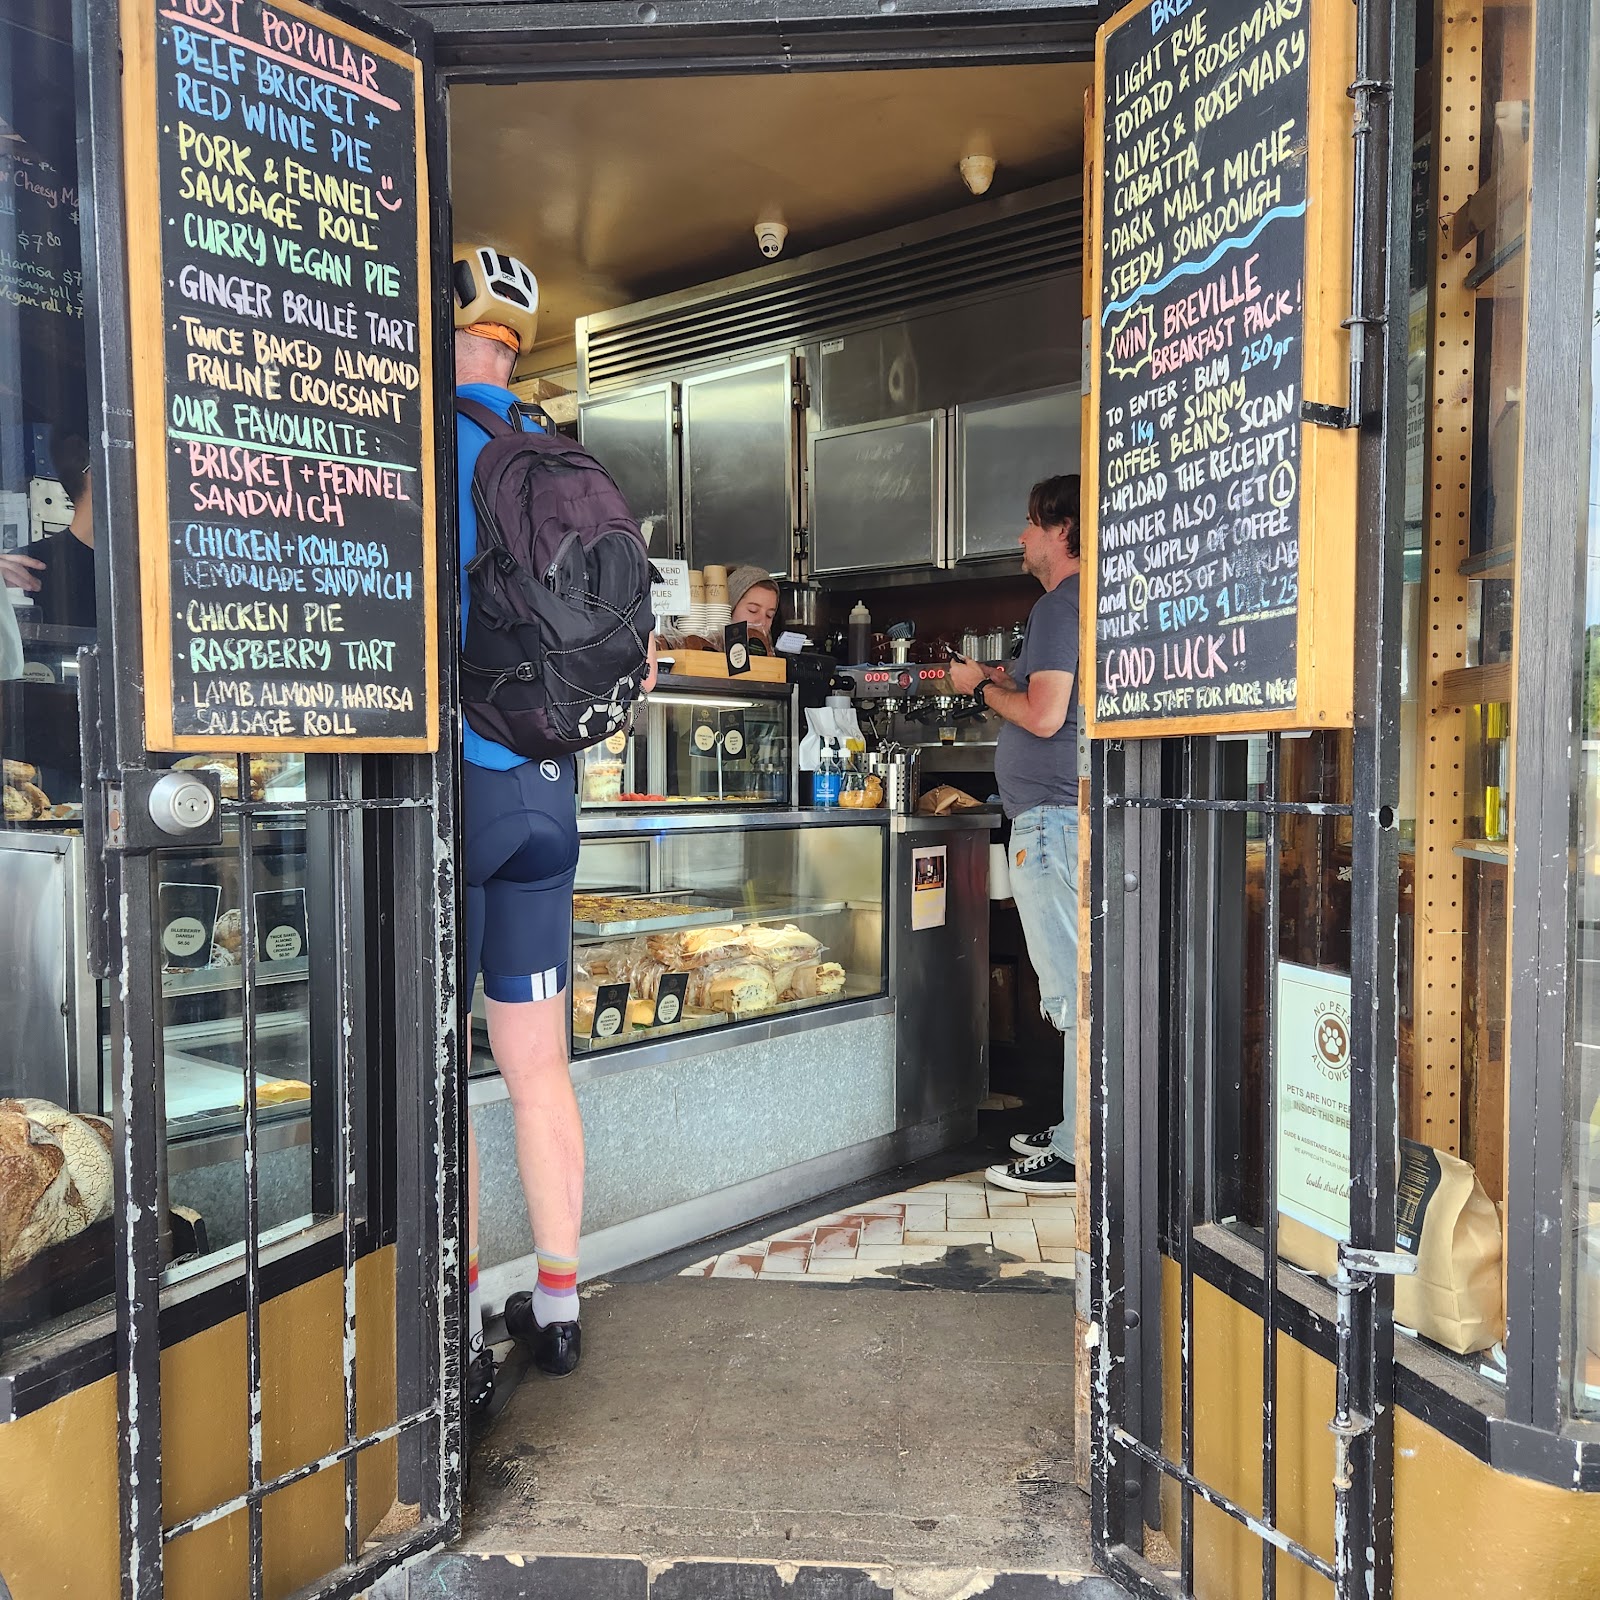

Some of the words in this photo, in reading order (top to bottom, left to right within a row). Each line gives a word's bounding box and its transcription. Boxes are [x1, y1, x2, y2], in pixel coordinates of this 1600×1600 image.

[262, 9, 379, 90] POPULAR
[1151, 0, 1192, 36] BRE
[171, 26, 245, 85] BEEF
[257, 57, 359, 126] BRISKET
[365, 111, 380, 130] +
[1115, 35, 1168, 106] LIGHT
[1171, 8, 1208, 67] RYE
[1115, 80, 1173, 144] POTATO
[1178, 65, 1191, 93] &
[1194, 0, 1302, 83] ROSEMARY
[175, 72, 231, 121] RED
[240, 94, 317, 153] WINE
[331, 128, 373, 174] PIE
[1114, 120, 1170, 184] OLIVES
[1172, 112, 1187, 142] &
[1195, 29, 1305, 132] ROSEMARY
[14, 170, 58, 208] Cheesy
[178, 121, 256, 183] PORK
[264, 158, 278, 183] &
[285, 157, 379, 220] FENNEL
[1112, 208, 1156, 259] DARK
[1164, 167, 1215, 227] MALT
[1223, 118, 1295, 195] MICHE
[1114, 141, 1200, 216] CIABATTA
[179, 166, 303, 231] SAUSAGE
[319, 207, 379, 250] ROLL
[1110, 242, 1164, 301] SEEDY
[1173, 175, 1281, 263] SOURDOUGH
[184, 213, 266, 266] CURRY
[273, 235, 351, 287] VEGAN
[364, 260, 400, 297] PIE
[41, 297, 61, 313] roll
[50, 286, 71, 302] roll
[179, 265, 272, 318] GINGER
[364, 311, 415, 352] TART
[1115, 315, 1147, 359] WIN
[1163, 253, 1262, 340] BREVILLE
[179, 315, 244, 355] TWICE
[252, 329, 322, 370] BAKED
[335, 347, 419, 390] ALMOND
[1106, 407, 1123, 427] TO
[1194, 354, 1230, 393] BUY
[1241, 333, 1293, 373] 250gr
[1152, 316, 1236, 380] BREAKFAST
[172, 394, 223, 436] OUR
[187, 353, 281, 400] PRALINE
[290, 372, 406, 423] CROISSANT
[1107, 435, 1124, 452] OR
[1160, 406, 1177, 431] OF
[1183, 376, 1246, 425] SUNNY
[1107, 441, 1161, 488] COFFEE
[1239, 385, 1294, 433] SCAN
[187, 441, 293, 491] BRISKET
[300, 465, 312, 483] +
[318, 461, 410, 500] FENNEL
[190, 482, 344, 526] SANDWICH
[1174, 457, 1206, 492] THE
[1101, 510, 1166, 551] WINNER
[1172, 494, 1216, 533] ALSO
[1227, 473, 1268, 511] GET
[1102, 552, 1139, 587] YEAR
[1143, 534, 1199, 573] SUPPLY
[1207, 524, 1229, 551] OF
[1233, 502, 1291, 545] COFFEE
[186, 599, 288, 632] CHICKEN
[303, 602, 345, 632] PIE
[312, 567, 412, 600] SANDWICH
[1099, 586, 1126, 614] and
[1148, 569, 1191, 600] CASES
[1197, 559, 1218, 590] OF
[1159, 594, 1209, 632] ENDS
[190, 637, 332, 672] RASPBERRY
[340, 638, 395, 671] TART
[1105, 647, 1155, 695] GOOD
[197, 710, 295, 736] SAUSAGE
[303, 710, 357, 735] ROLL
[341, 682, 414, 712] HARISSA
[1097, 694, 1120, 718] ASK
[1123, 690, 1150, 714] OUR
[1153, 686, 1194, 713] STAFF
[1196, 686, 1226, 710] FOR
[1225, 680, 1263, 706] MORE
[1266, 677, 1297, 702] INFO
[1313, 1002, 1326, 1017] NO
[1329, 1000, 1351, 1025] PETS
[1286, 1083, 1304, 1097] PETS
[1305, 1091, 1320, 1103] ARE
[1321, 1096, 1336, 1109] NOT
[1293, 1100, 1316, 1116] INSIDE
[1317, 1109, 1334, 1123] THIS
